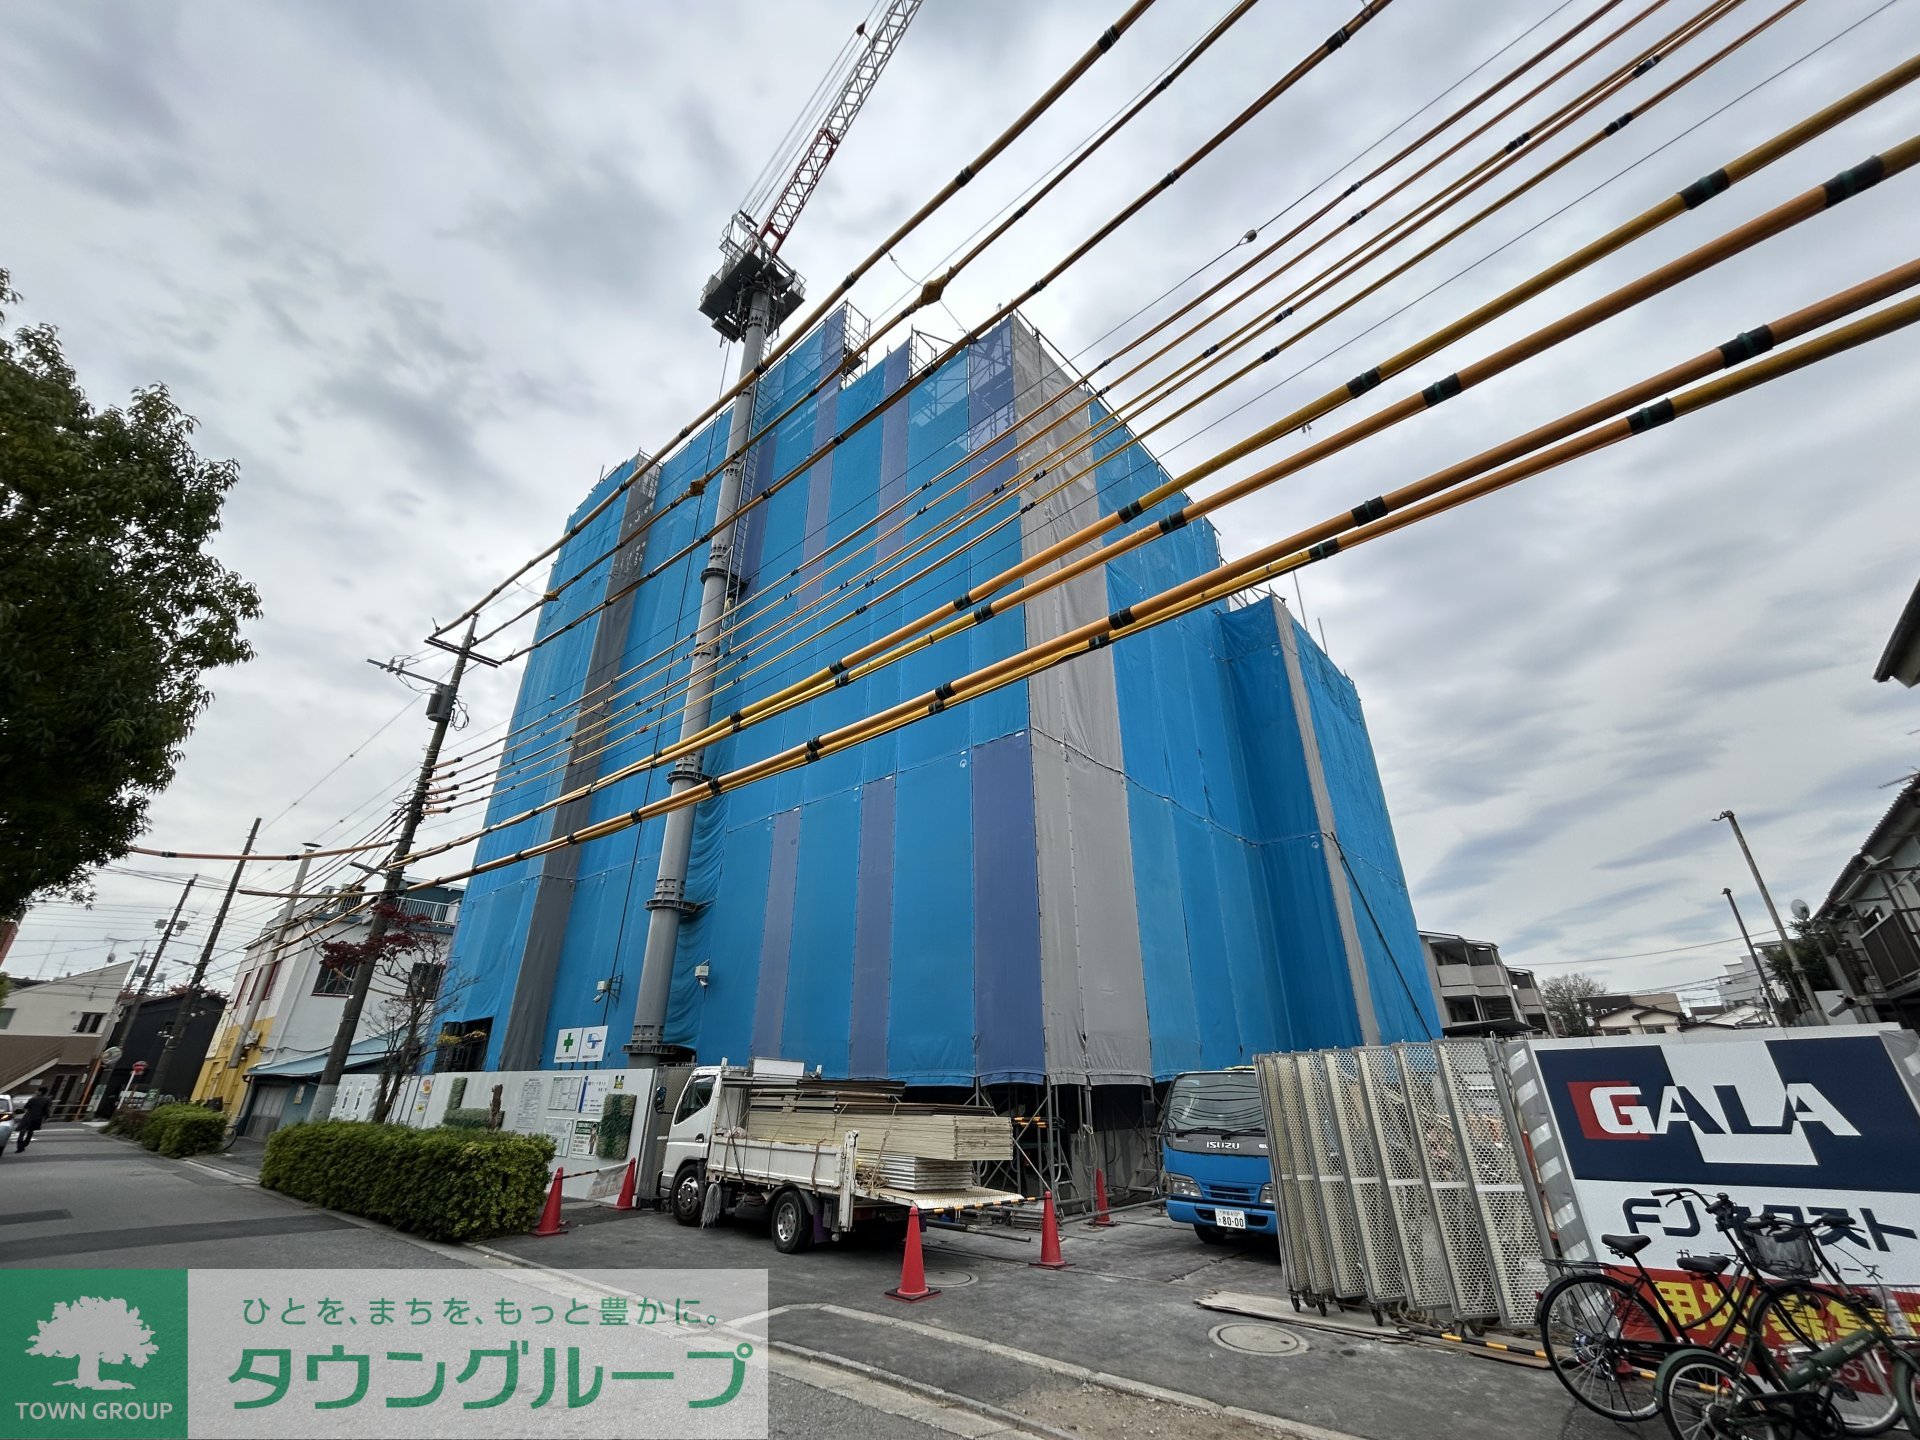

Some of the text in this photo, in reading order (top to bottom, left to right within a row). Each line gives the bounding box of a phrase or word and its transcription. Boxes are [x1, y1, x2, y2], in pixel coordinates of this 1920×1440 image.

[1589, 1083, 1862, 1136] GALA
[1206, 1141, 1240, 1149] ISUZU
[1222, 1216, 1244, 1227] 80-00
[1622, 1197, 1918, 1253] FJクスト
